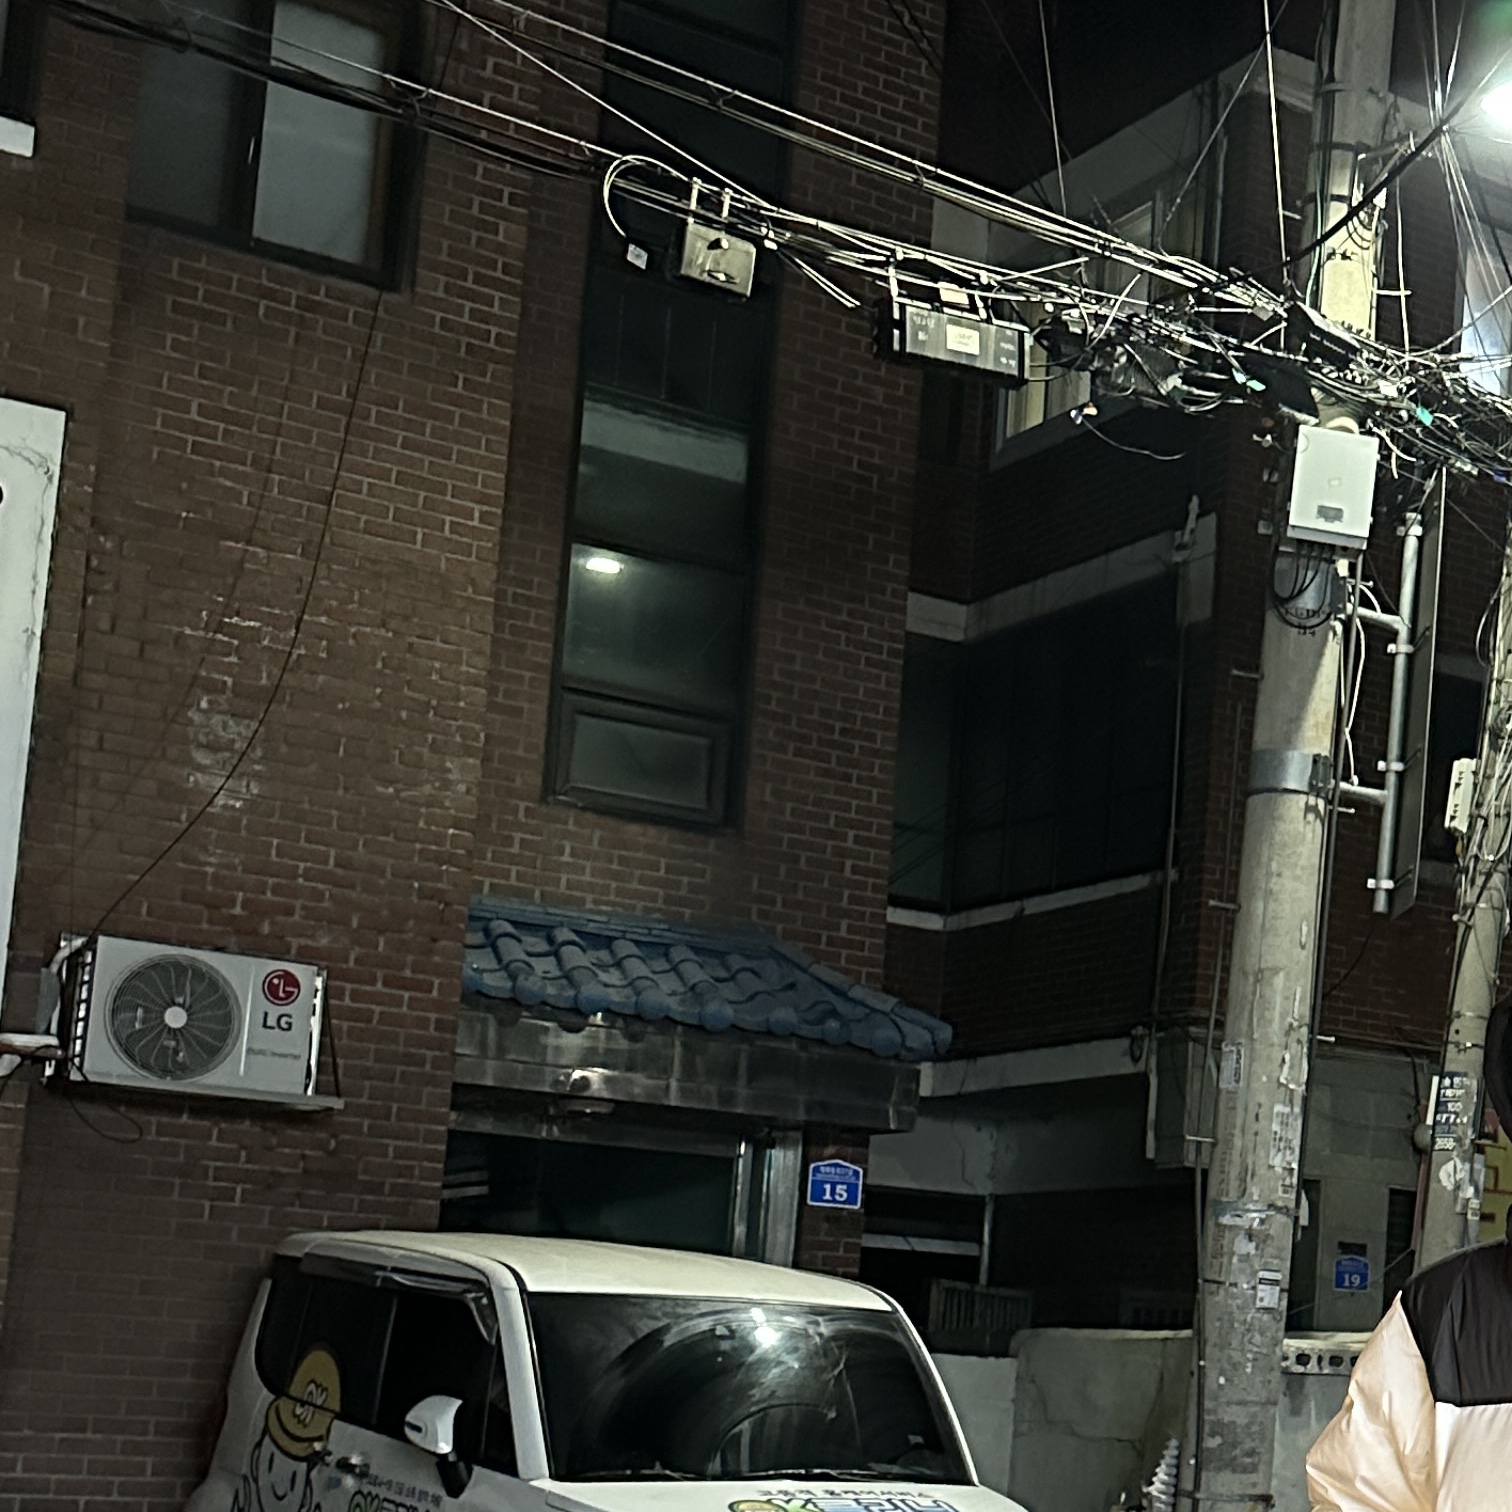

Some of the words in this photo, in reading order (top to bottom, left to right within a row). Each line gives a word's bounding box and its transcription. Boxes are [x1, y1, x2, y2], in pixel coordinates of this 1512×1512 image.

[262, 1011, 294, 1032] LG
[822, 1182, 848, 1202] 15
[1342, 1273, 1361, 1288] 19
